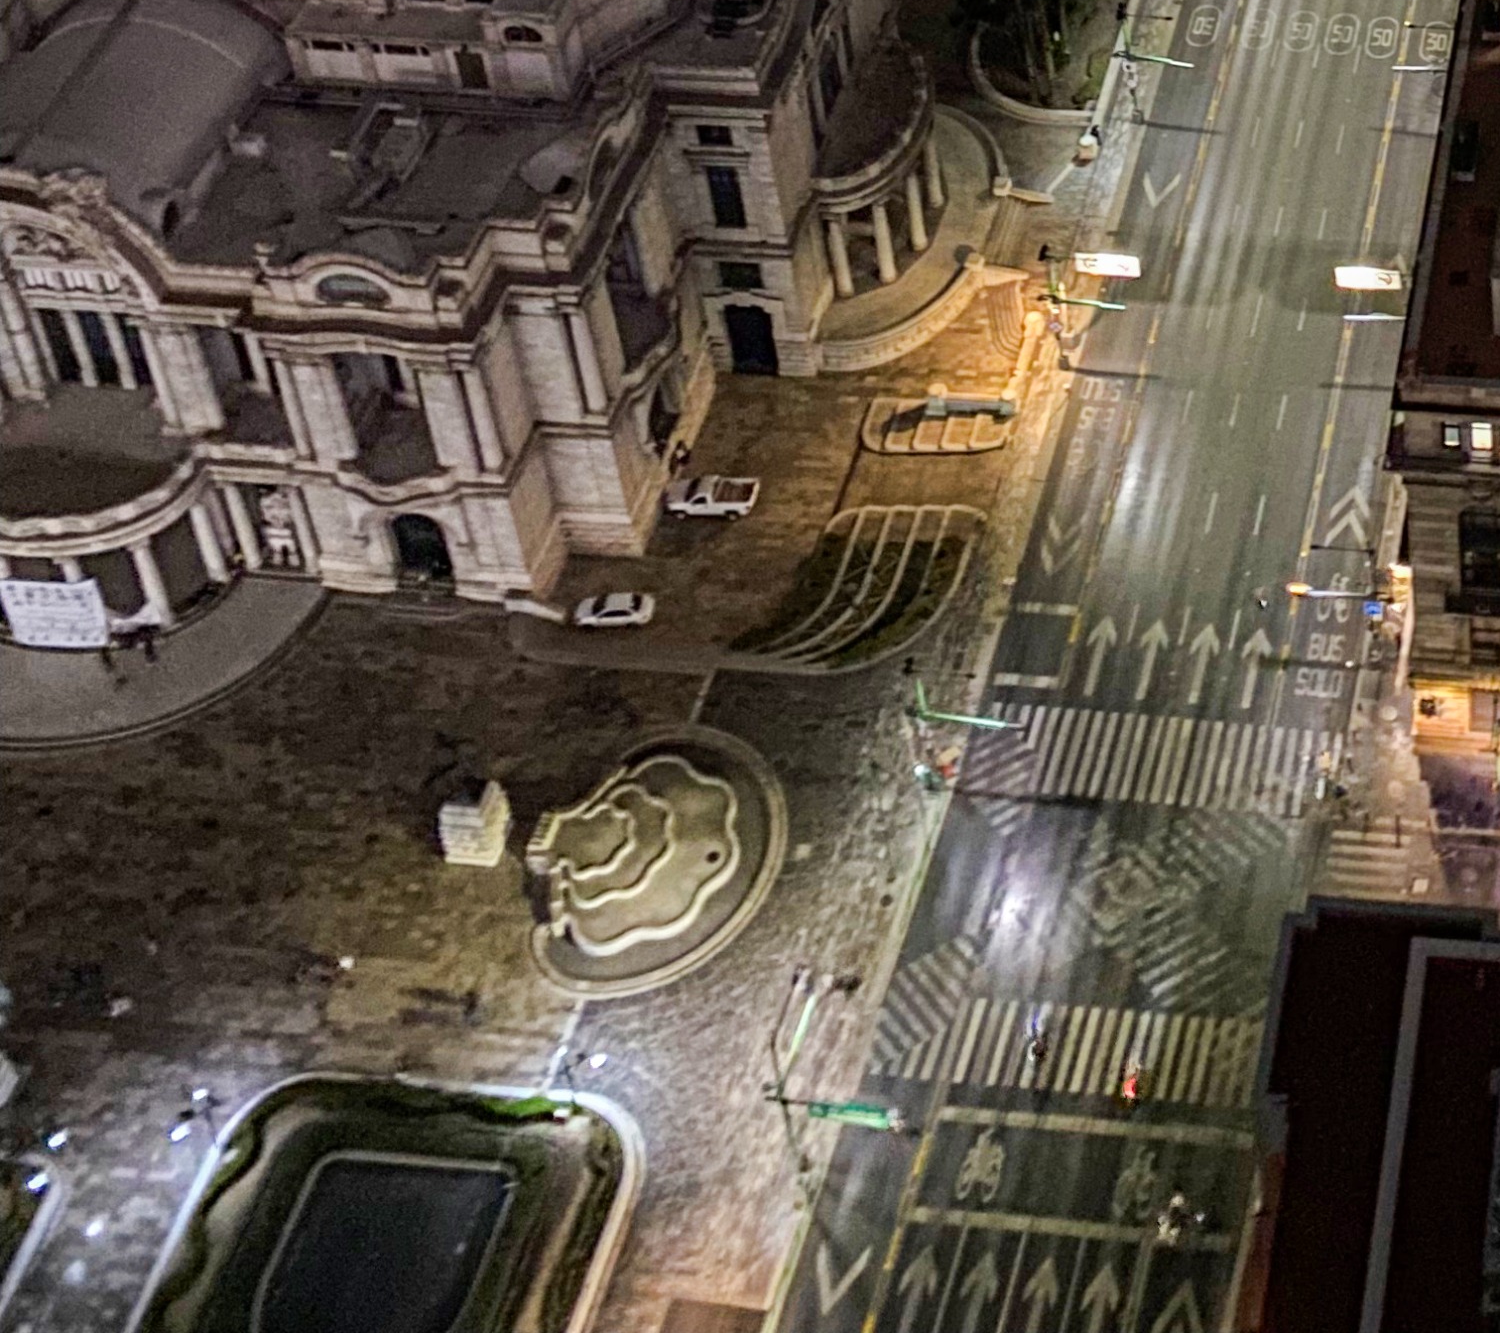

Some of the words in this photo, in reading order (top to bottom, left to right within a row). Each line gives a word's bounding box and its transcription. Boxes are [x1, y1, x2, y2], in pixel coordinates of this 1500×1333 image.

[1290, 21, 1313, 40] 50
[1331, 24, 1354, 44] 50
[1371, 28, 1393, 47] 50
[1425, 32, 1448, 52] 30
[1306, 632, 1346, 661] BUS
[1293, 667, 1344, 698] SOLO
